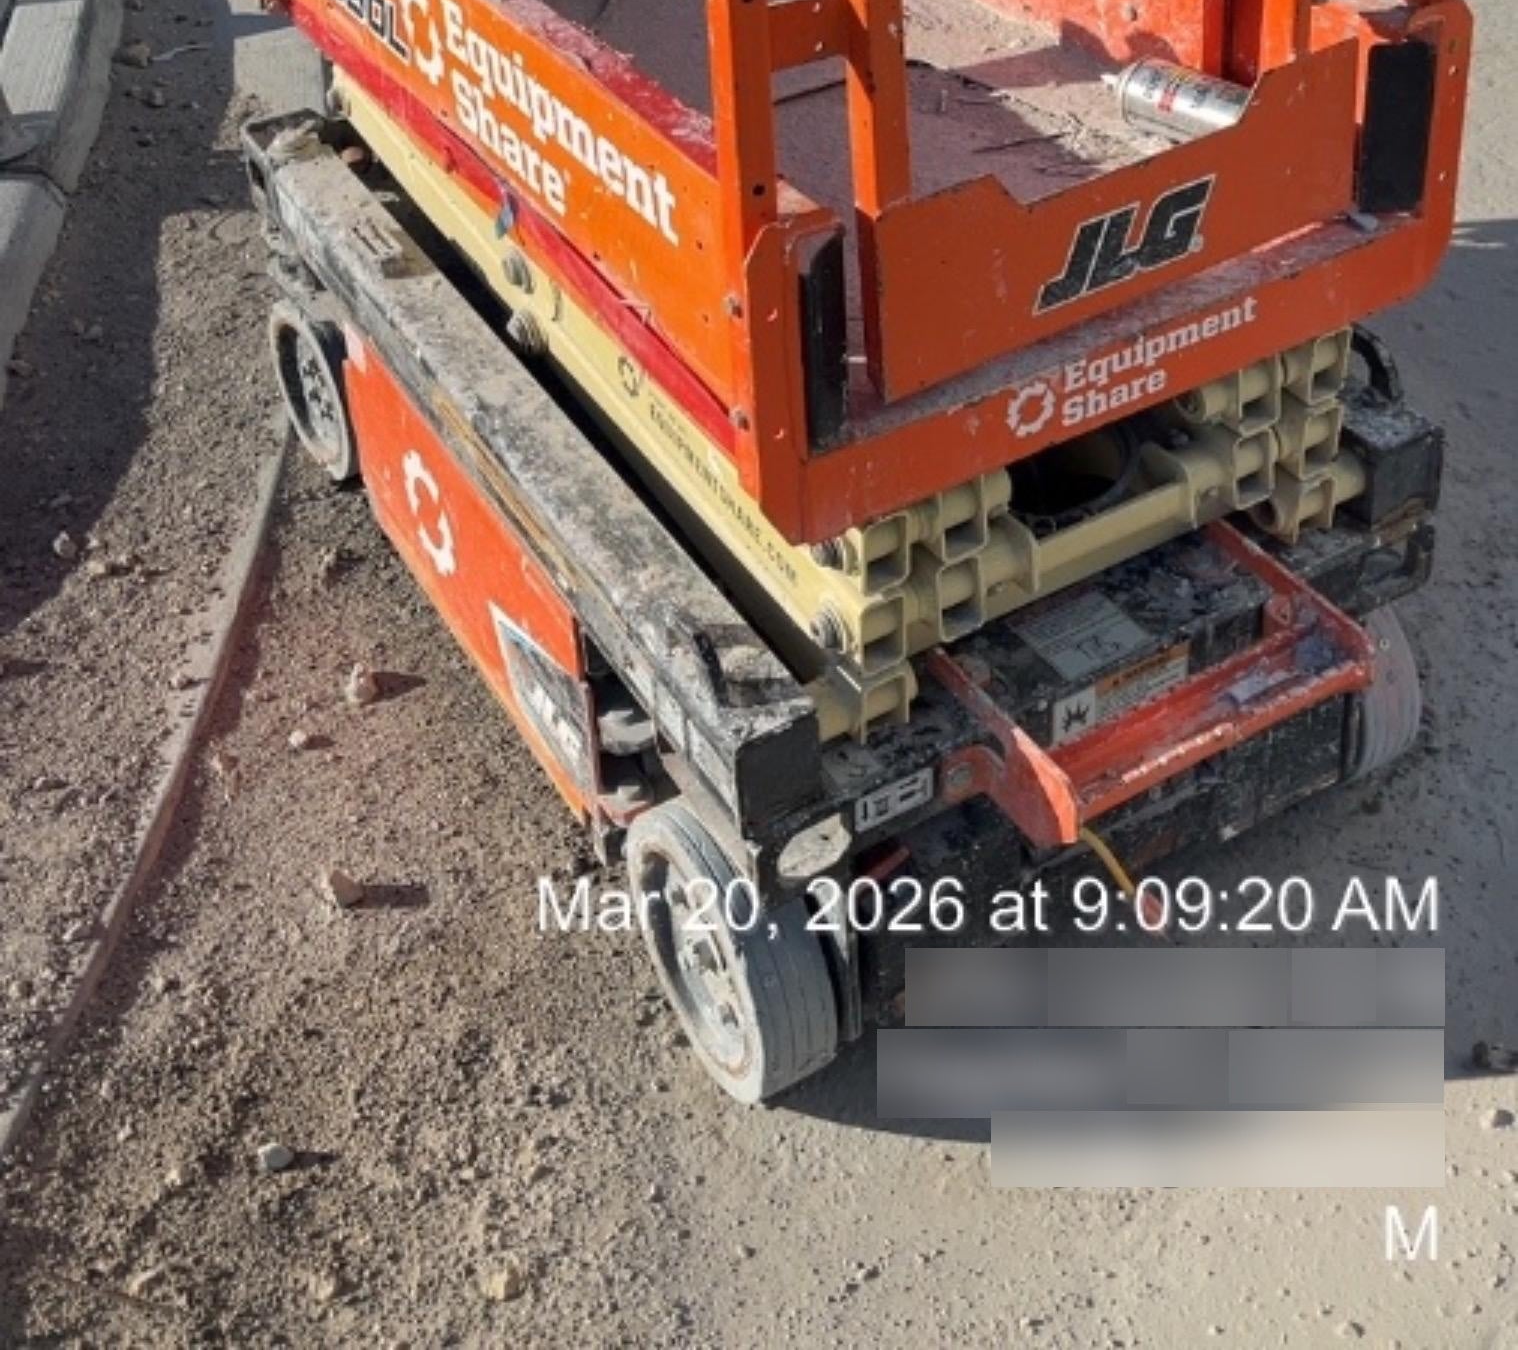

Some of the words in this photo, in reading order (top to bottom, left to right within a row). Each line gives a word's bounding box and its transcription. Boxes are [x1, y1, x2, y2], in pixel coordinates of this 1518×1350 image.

[451, 77, 567, 217] Share
[1032, 173, 1217, 317] JLG
[1061, 366, 1167, 428] Share
[1062, 295, 1259, 390] Equipment
